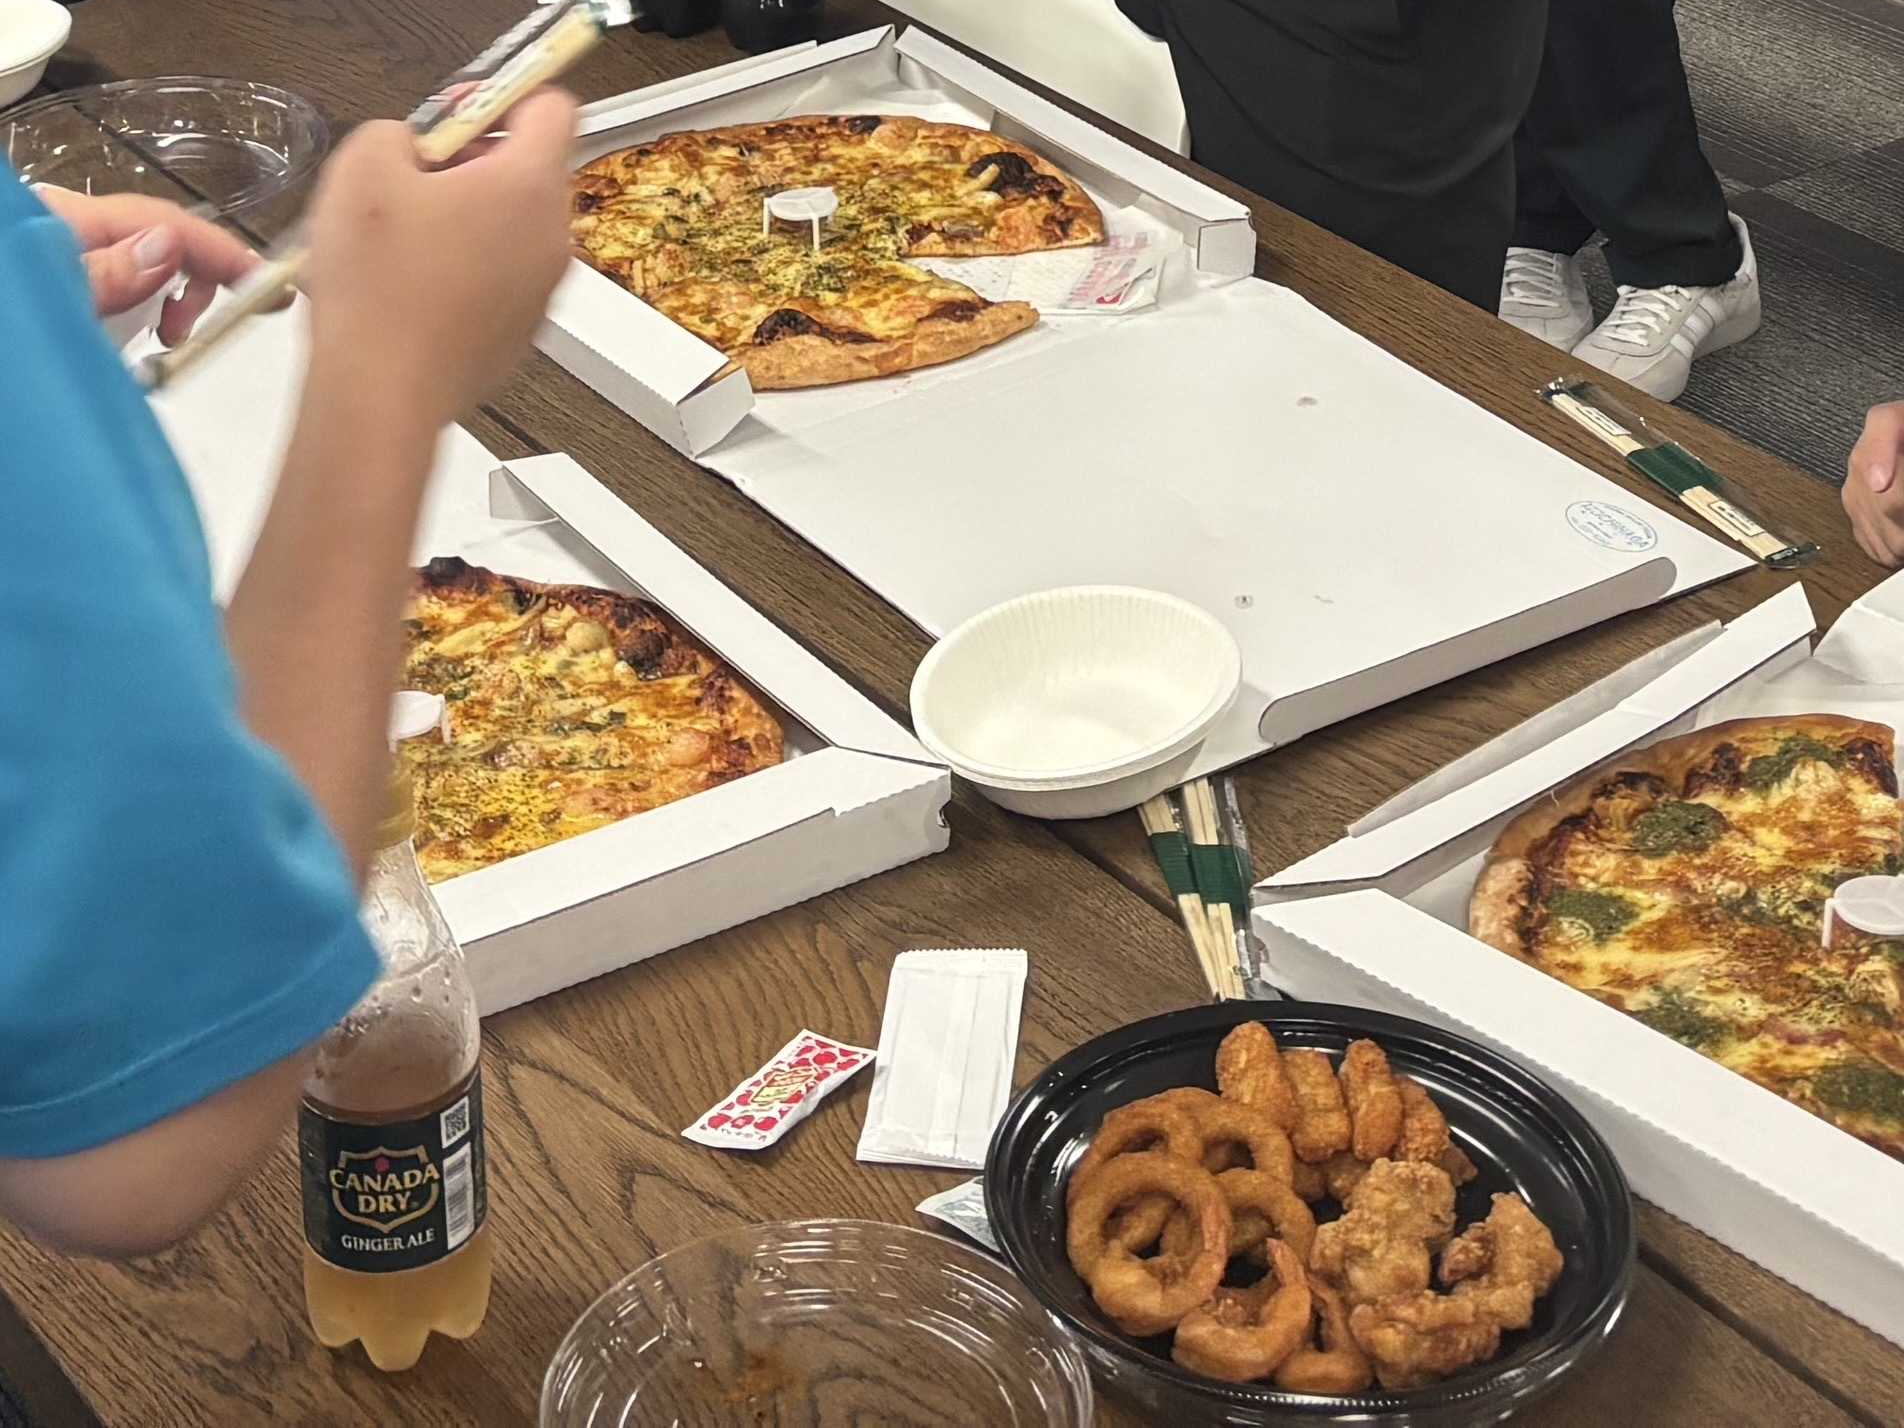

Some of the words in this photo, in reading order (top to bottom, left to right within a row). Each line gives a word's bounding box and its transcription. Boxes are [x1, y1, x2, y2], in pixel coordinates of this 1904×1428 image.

[328, 1162, 441, 1193] CANADA
[357, 1191, 412, 1214] DRY
[341, 1234, 406, 1252] GINGER
[407, 1228, 436, 1248] ALE
